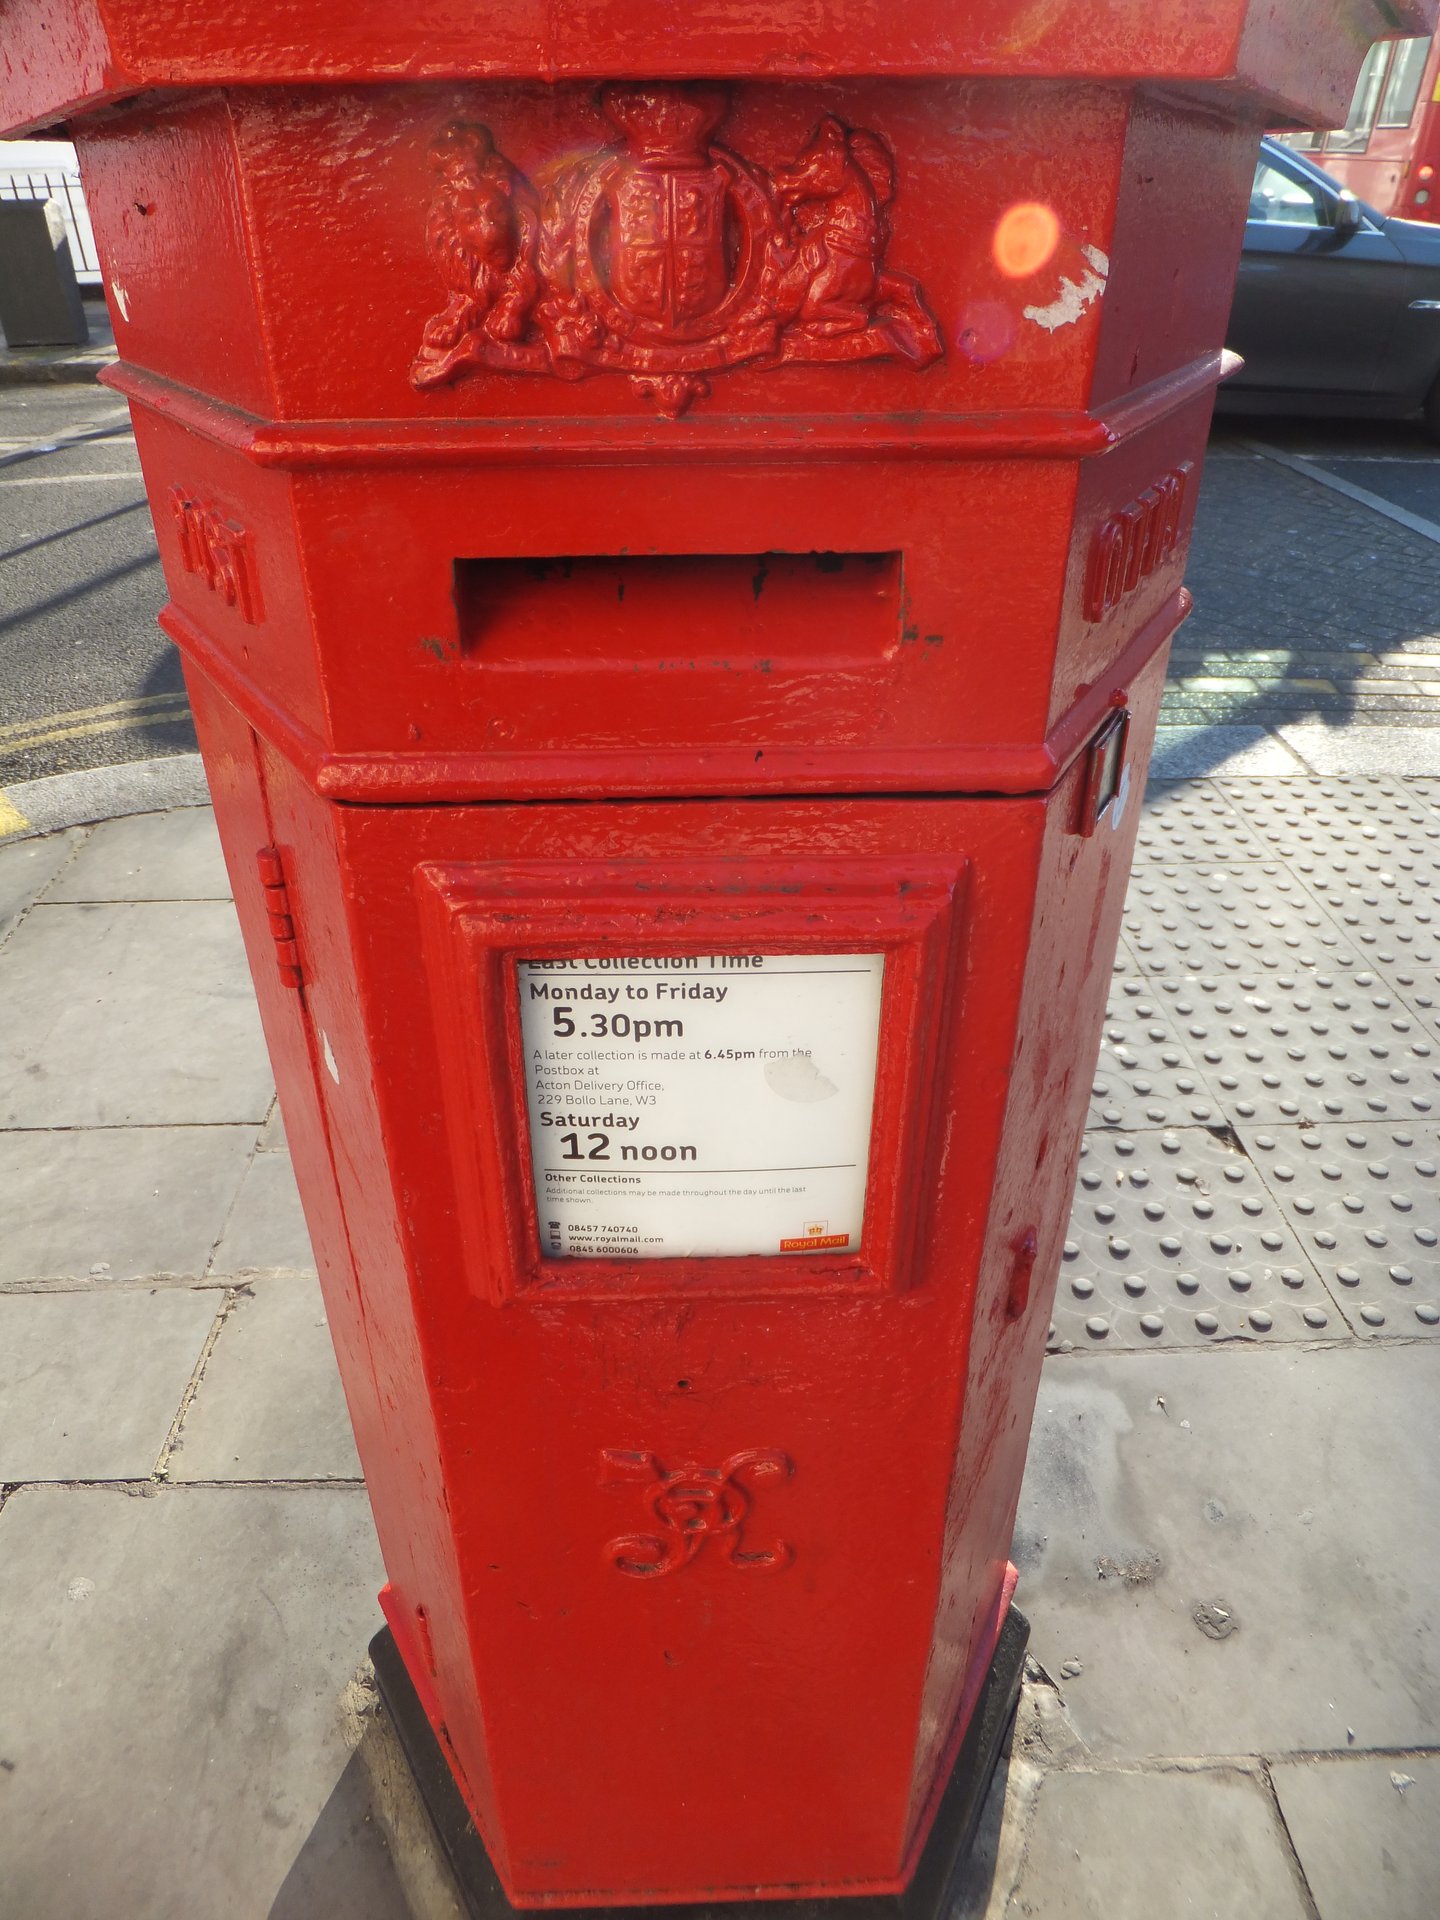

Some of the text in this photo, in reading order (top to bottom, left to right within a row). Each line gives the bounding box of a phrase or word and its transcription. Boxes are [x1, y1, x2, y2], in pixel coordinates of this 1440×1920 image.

[584, 956, 699, 970] Collection
[530, 982, 729, 1003] Monday to Friday
[553, 1006, 684, 1042] 5.30pm
[533, 1047, 812, 1061] A later collection is made at 6.45pm from the
[535, 1064, 600, 1075] Postbox at
[535, 1079, 665, 1092] Acton Delivery Office,
[537, 1094, 657, 1106] 229 Bollo Lane, W3
[540, 1111, 640, 1131] Saturday
[560, 1132, 698, 1161] 12 noon
[545, 1173, 641, 1184] Other Collections
[545, 1185, 807, 1197] Additional collections may be made throughout the day until the last
[568, 1224, 639, 1234] 08457 740740
[568, 1235, 664, 1244] www.royalmail.com
[784, 1235, 846, 1249] Royal Mail
[569, 1245, 594, 1253] 0845
